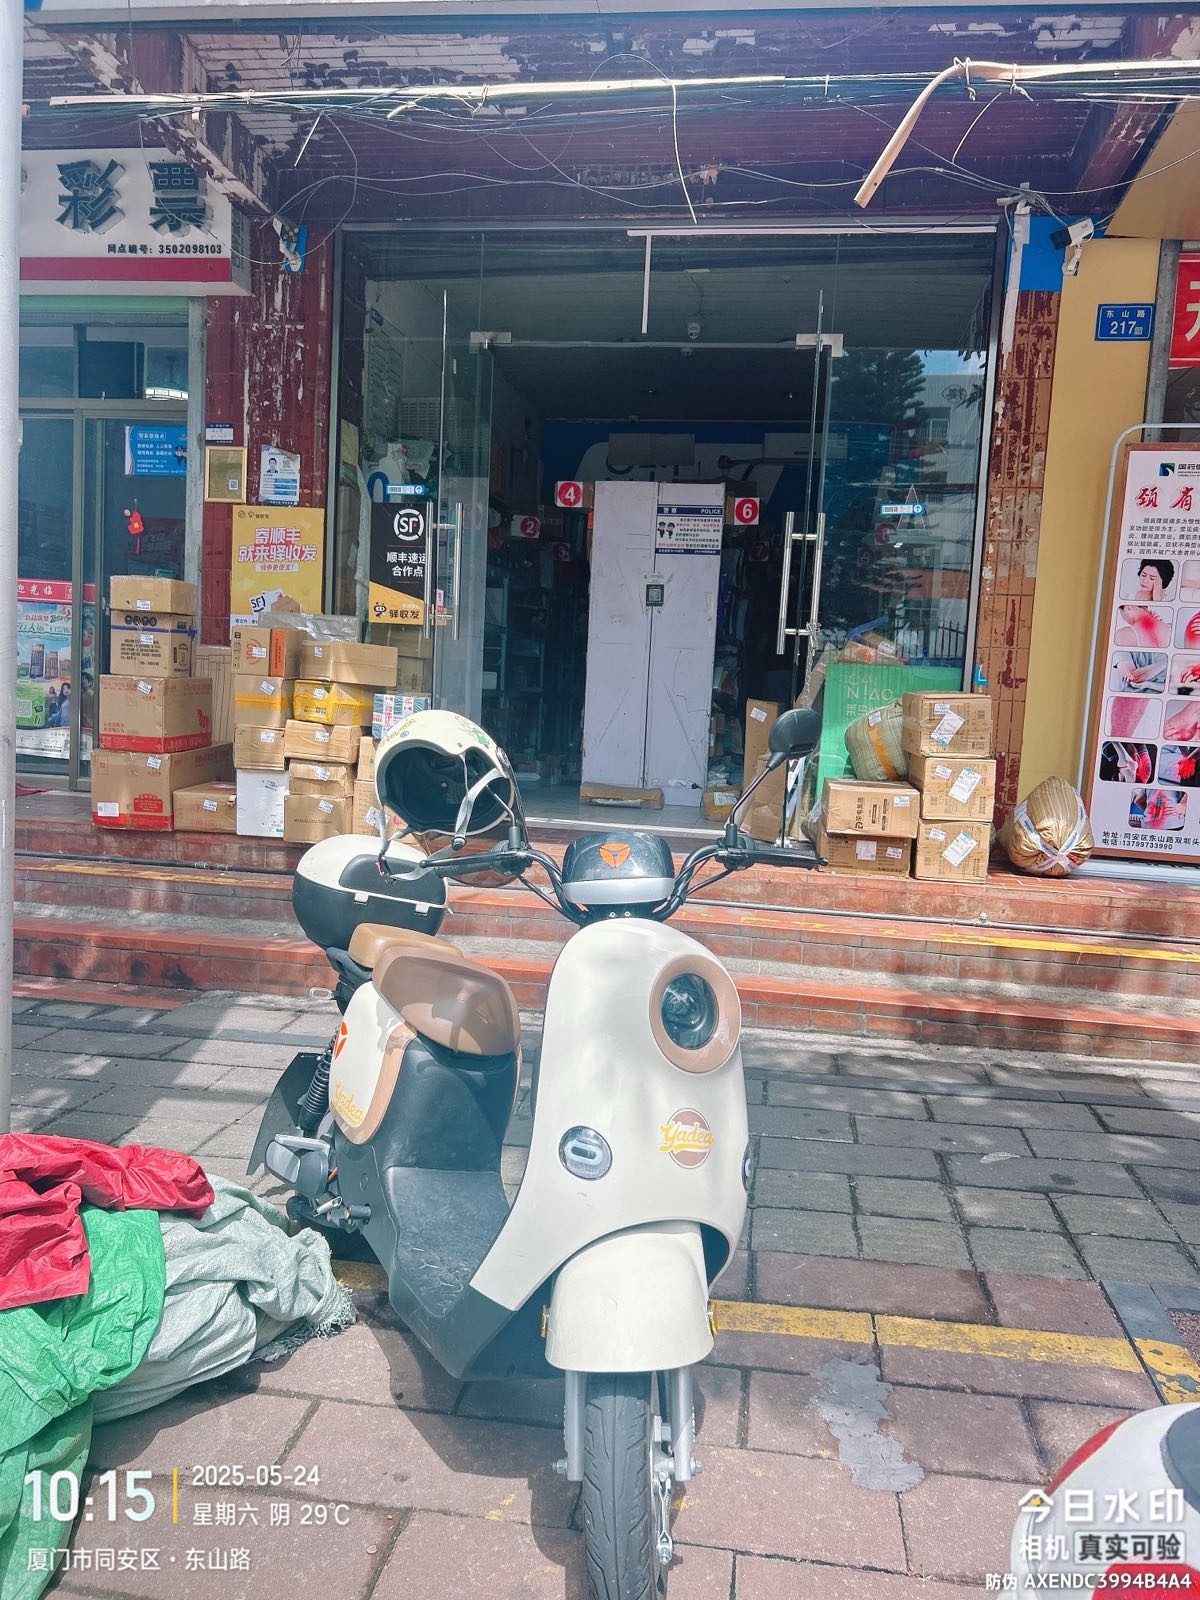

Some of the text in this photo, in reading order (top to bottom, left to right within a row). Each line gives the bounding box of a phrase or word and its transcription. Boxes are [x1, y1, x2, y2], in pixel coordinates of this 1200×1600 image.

[56, 159, 208, 233] 彩票
[1106, 310, 1145, 318] 东山路
[565, 487, 576, 502] 4
[743, 503, 752, 519] 6
[527, 521, 534, 533] 2
[255, 527, 301, 544] 寄顺丰
[238, 545, 317, 562] 就来驿收发
[392, 566, 424, 577] 合作点
[389, 609, 420, 619] 驿收发
